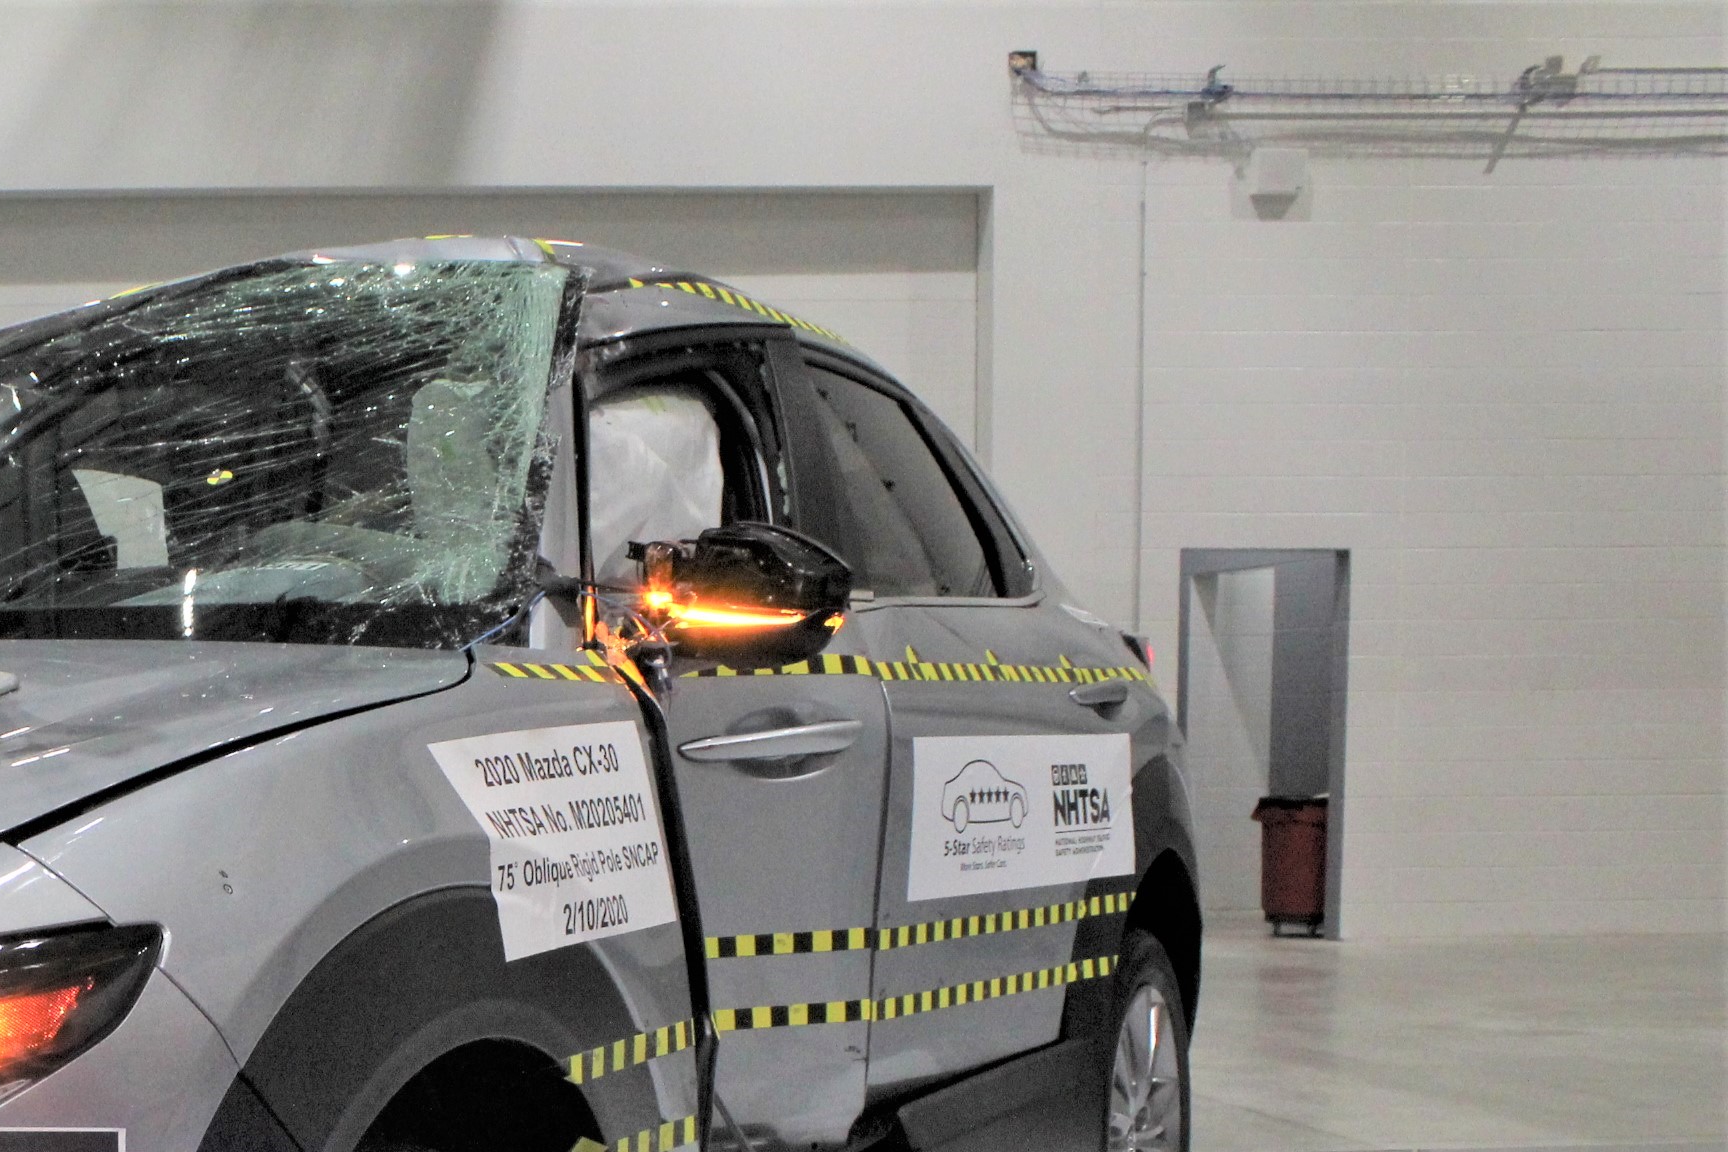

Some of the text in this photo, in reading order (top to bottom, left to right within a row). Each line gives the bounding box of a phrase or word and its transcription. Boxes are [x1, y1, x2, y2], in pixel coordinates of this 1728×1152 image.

[475, 744, 619, 787] 2020 Mazda CX-30
[486, 793, 647, 838] NHTSA No. M20205401
[1053, 788, 1110, 826] NHTSA
[523, 859, 574, 887] Oblique
[571, 854, 598, 882] Rigid
[598, 850, 622, 873] Pole
[623, 841, 659, 869] SNCAP
[944, 835, 1025, 857] 5-Star Safety Ratings
[563, 894, 629, 936] 2/10/2020
